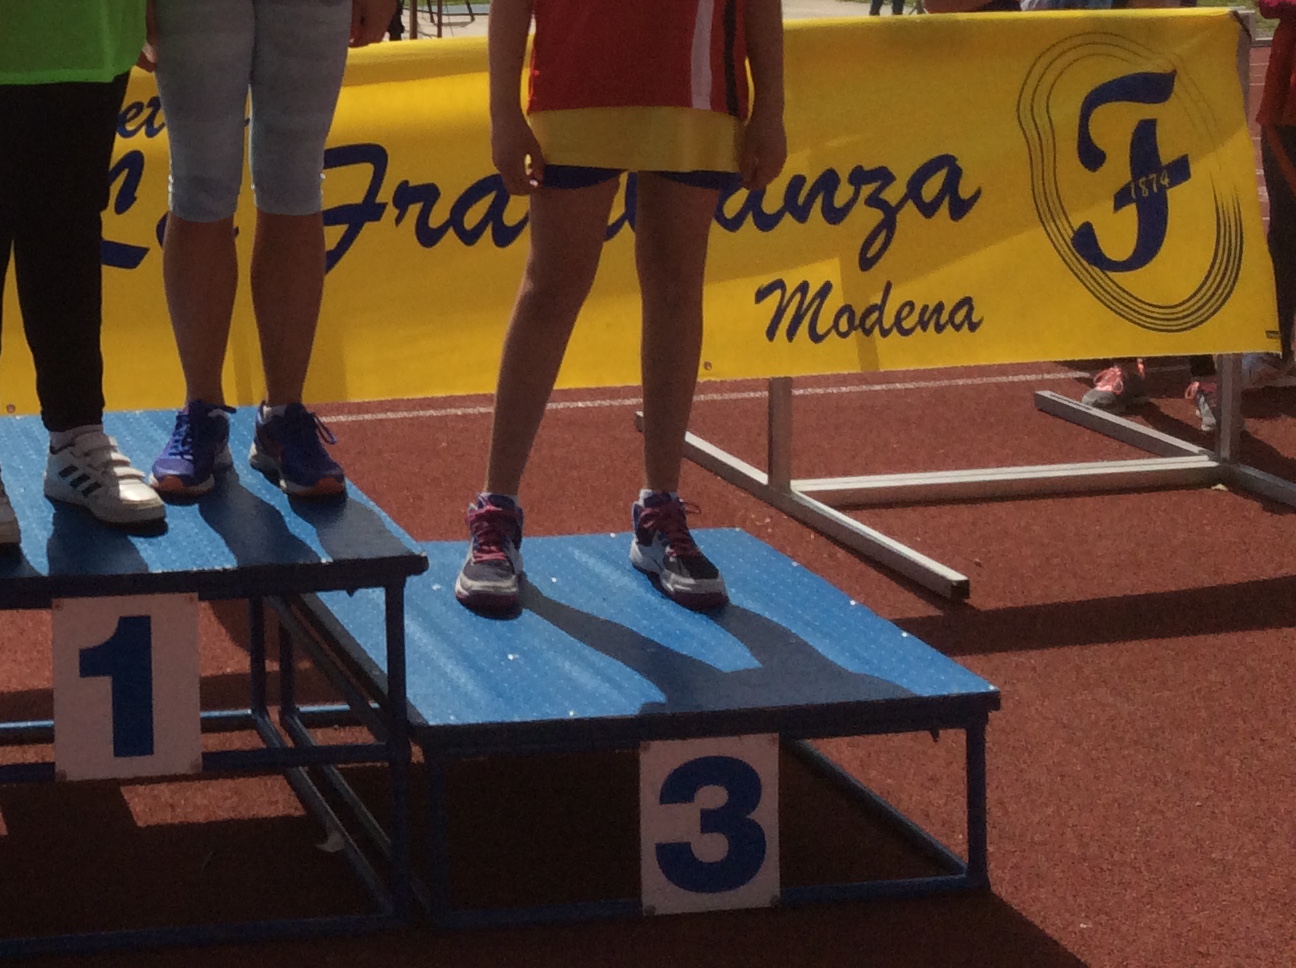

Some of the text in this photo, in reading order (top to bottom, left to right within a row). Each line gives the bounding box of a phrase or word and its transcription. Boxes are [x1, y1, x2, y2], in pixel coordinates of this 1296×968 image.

[322, 142, 983, 275] Fraanza
[1129, 169, 1170, 200] 1874
[755, 279, 984, 344] Modena
[79, 615, 155, 758] 1
[655, 755, 767, 893] 3
